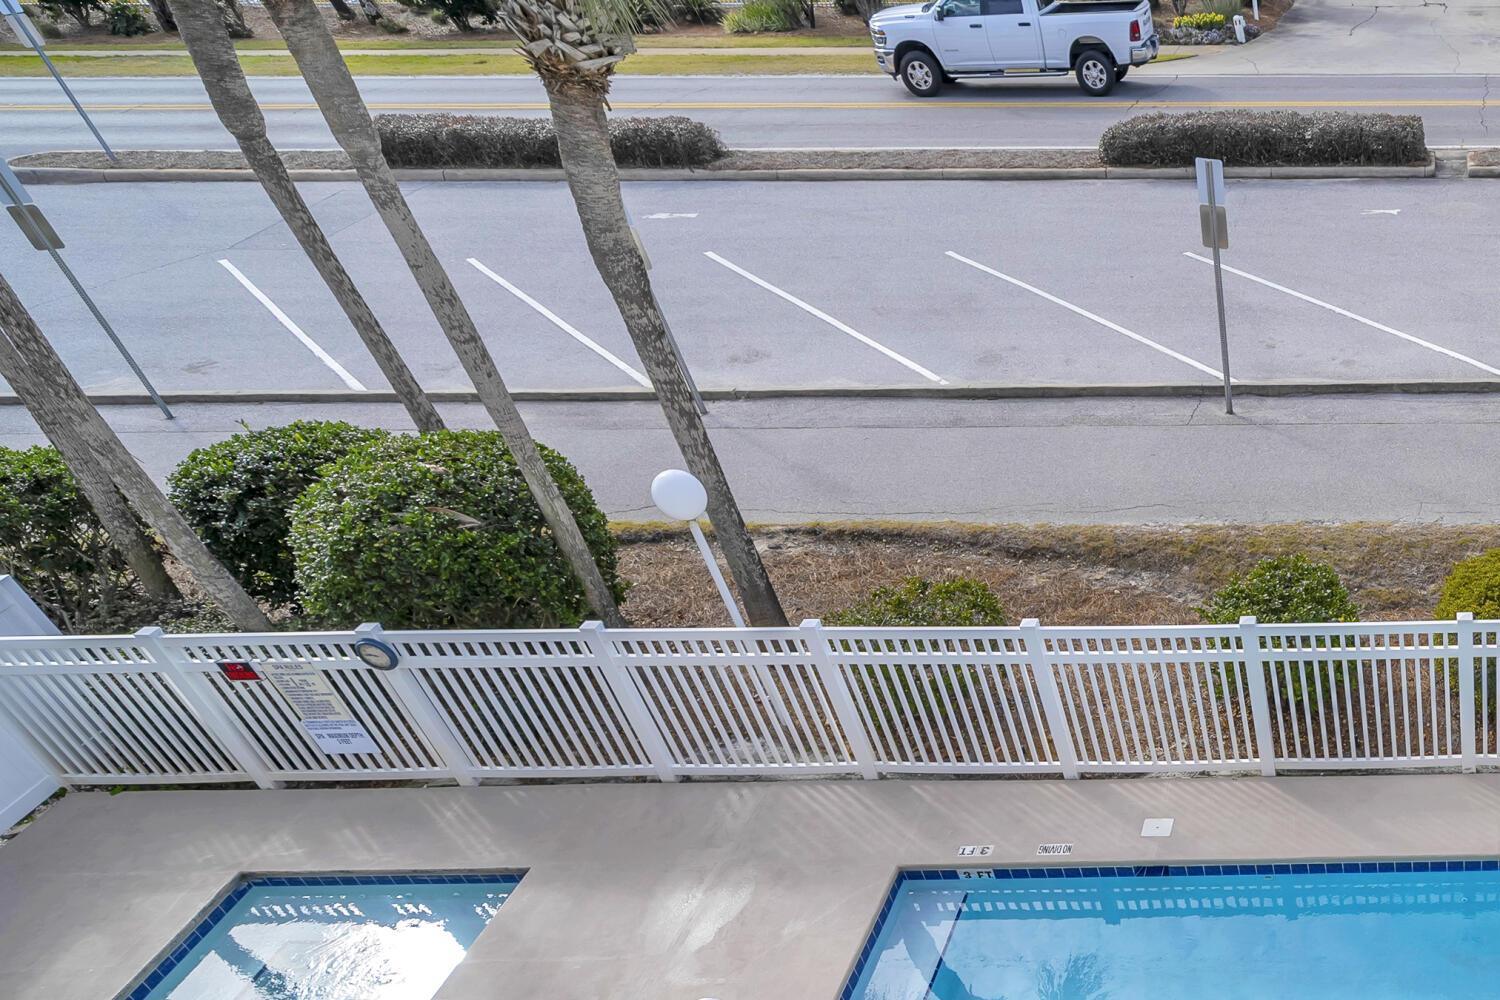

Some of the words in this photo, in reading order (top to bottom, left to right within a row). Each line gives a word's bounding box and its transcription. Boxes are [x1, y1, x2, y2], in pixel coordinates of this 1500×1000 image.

[980, 846, 990, 855] 3
[1037, 845, 1063, 855] DIVING
[1062, 844, 1073, 854] NO
[963, 871, 972, 879] 3
[976, 870, 992, 879] FT
